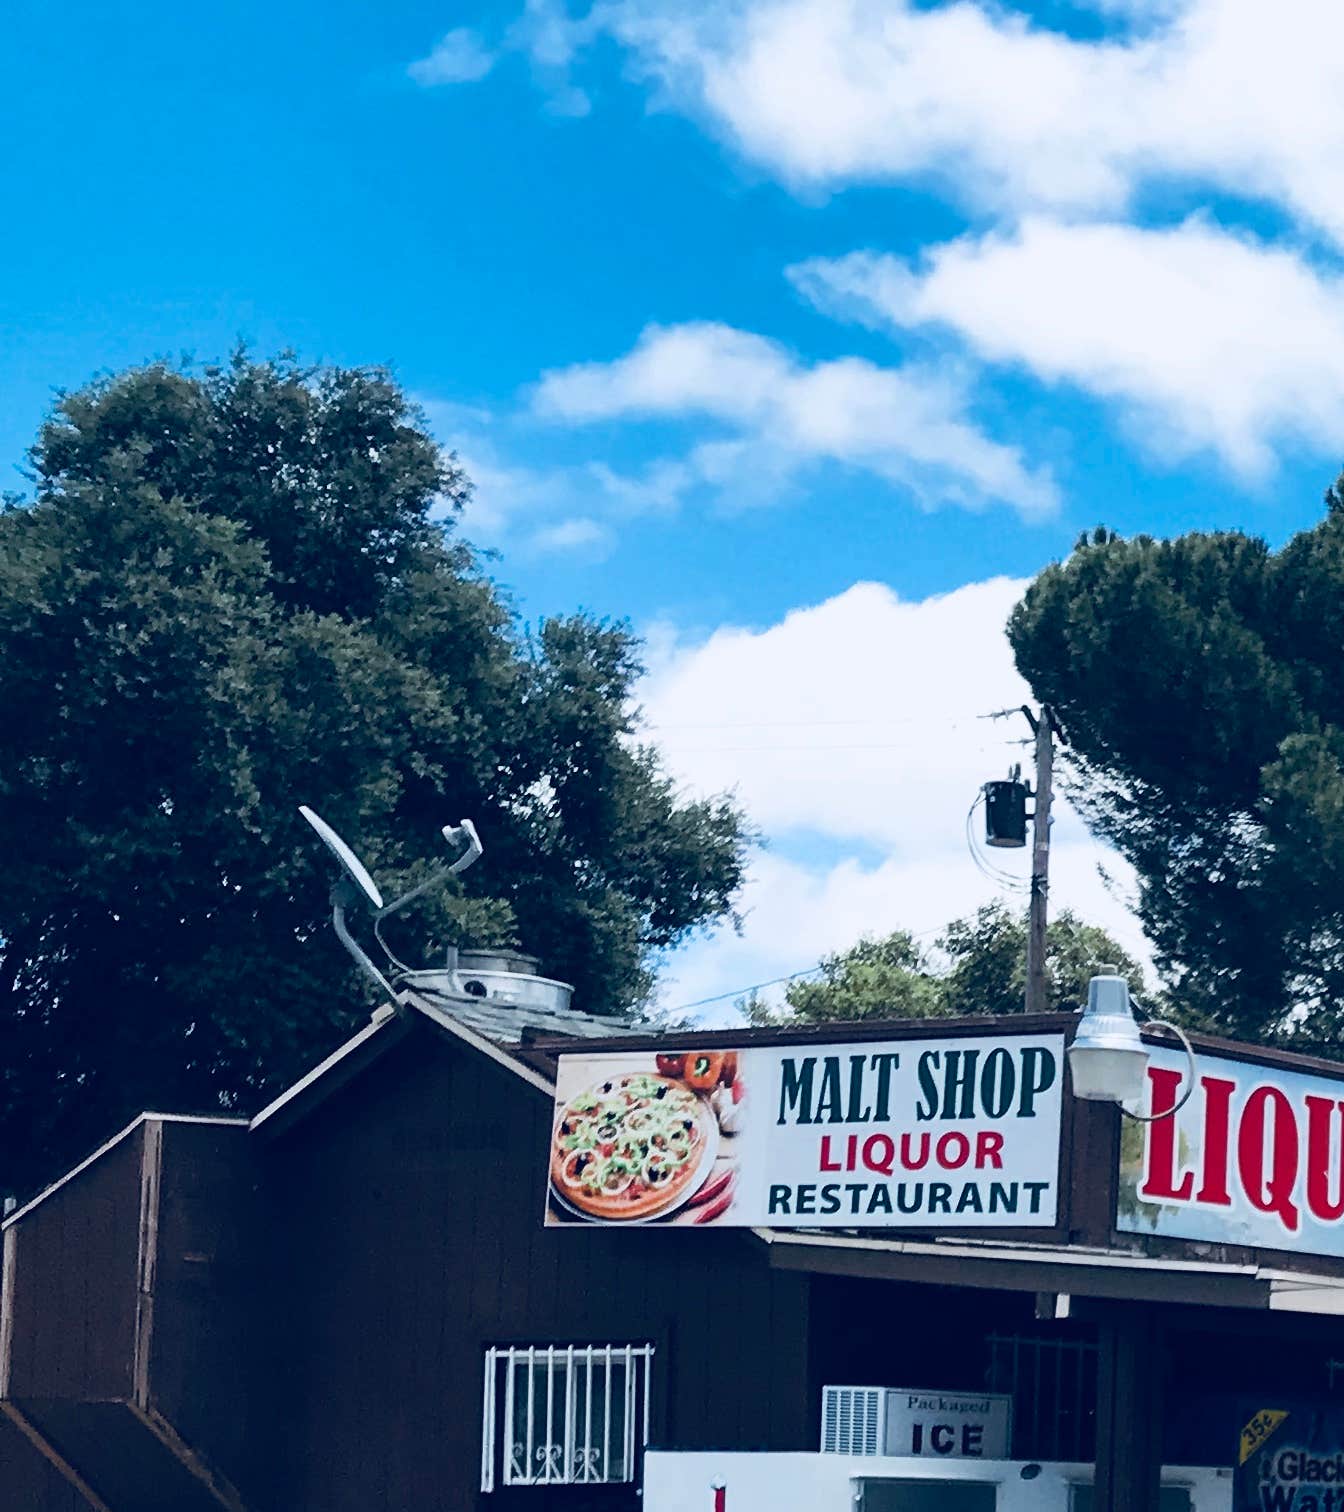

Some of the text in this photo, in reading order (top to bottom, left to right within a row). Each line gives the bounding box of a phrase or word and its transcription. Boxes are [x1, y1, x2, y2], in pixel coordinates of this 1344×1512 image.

[777, 1047, 1056, 1125] MALT SHOP
[819, 1131, 1004, 1176] LIQUOR
[768, 1182, 1049, 1214] RESTAURANT
[907, 1395, 991, 1413] Packaged
[912, 1423, 984, 1456] ICE
